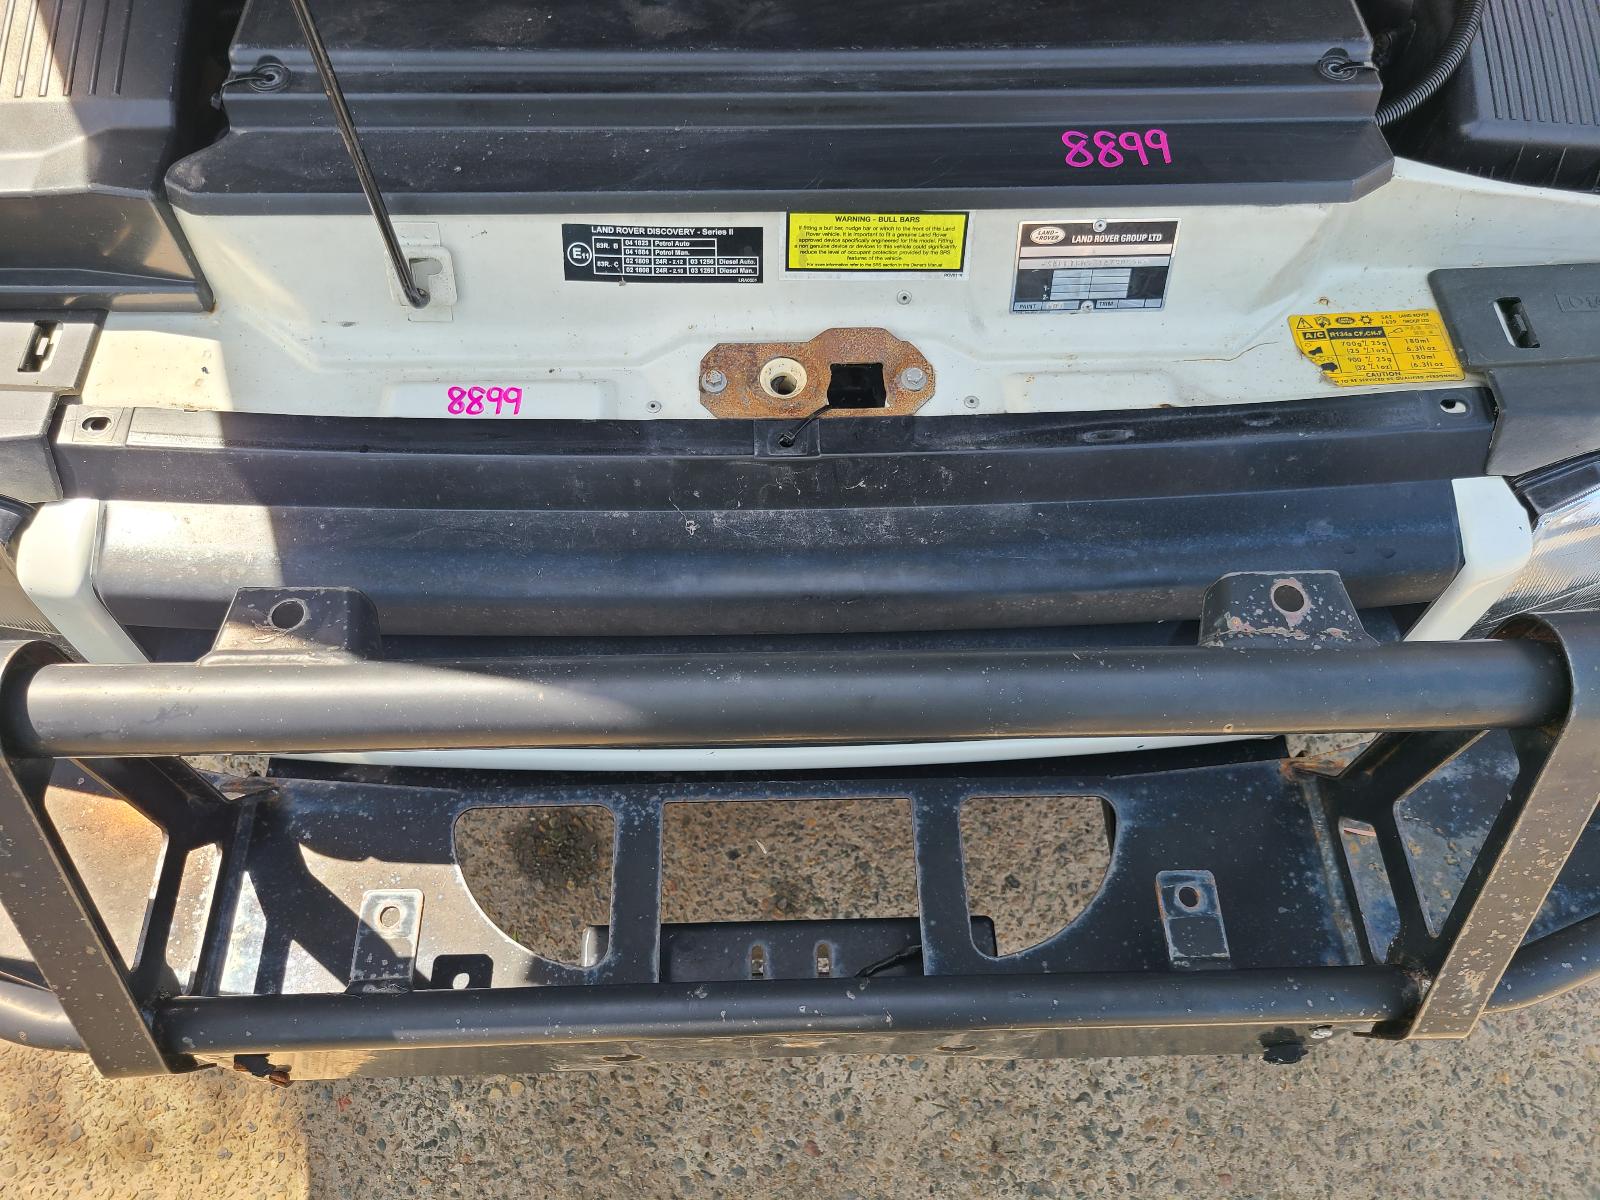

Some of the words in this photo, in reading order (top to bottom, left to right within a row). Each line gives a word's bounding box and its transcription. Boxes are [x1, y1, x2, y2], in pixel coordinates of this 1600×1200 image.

[1062, 129, 1172, 168] 8899
[591, 226, 614, 234] LAND
[616, 226, 645, 235] ROVER
[647, 227, 696, 237] DISCOVERY
[702, 228, 727, 237] Series
[1071, 235, 1093, 244] LAND
[1094, 234, 1120, 243] ROVER
[1121, 234, 1147, 243] GROUP
[1148, 233, 1162, 242] LTD
[1304, 331, 1325, 339] A/C
[448, 386, 522, 415] 8899
